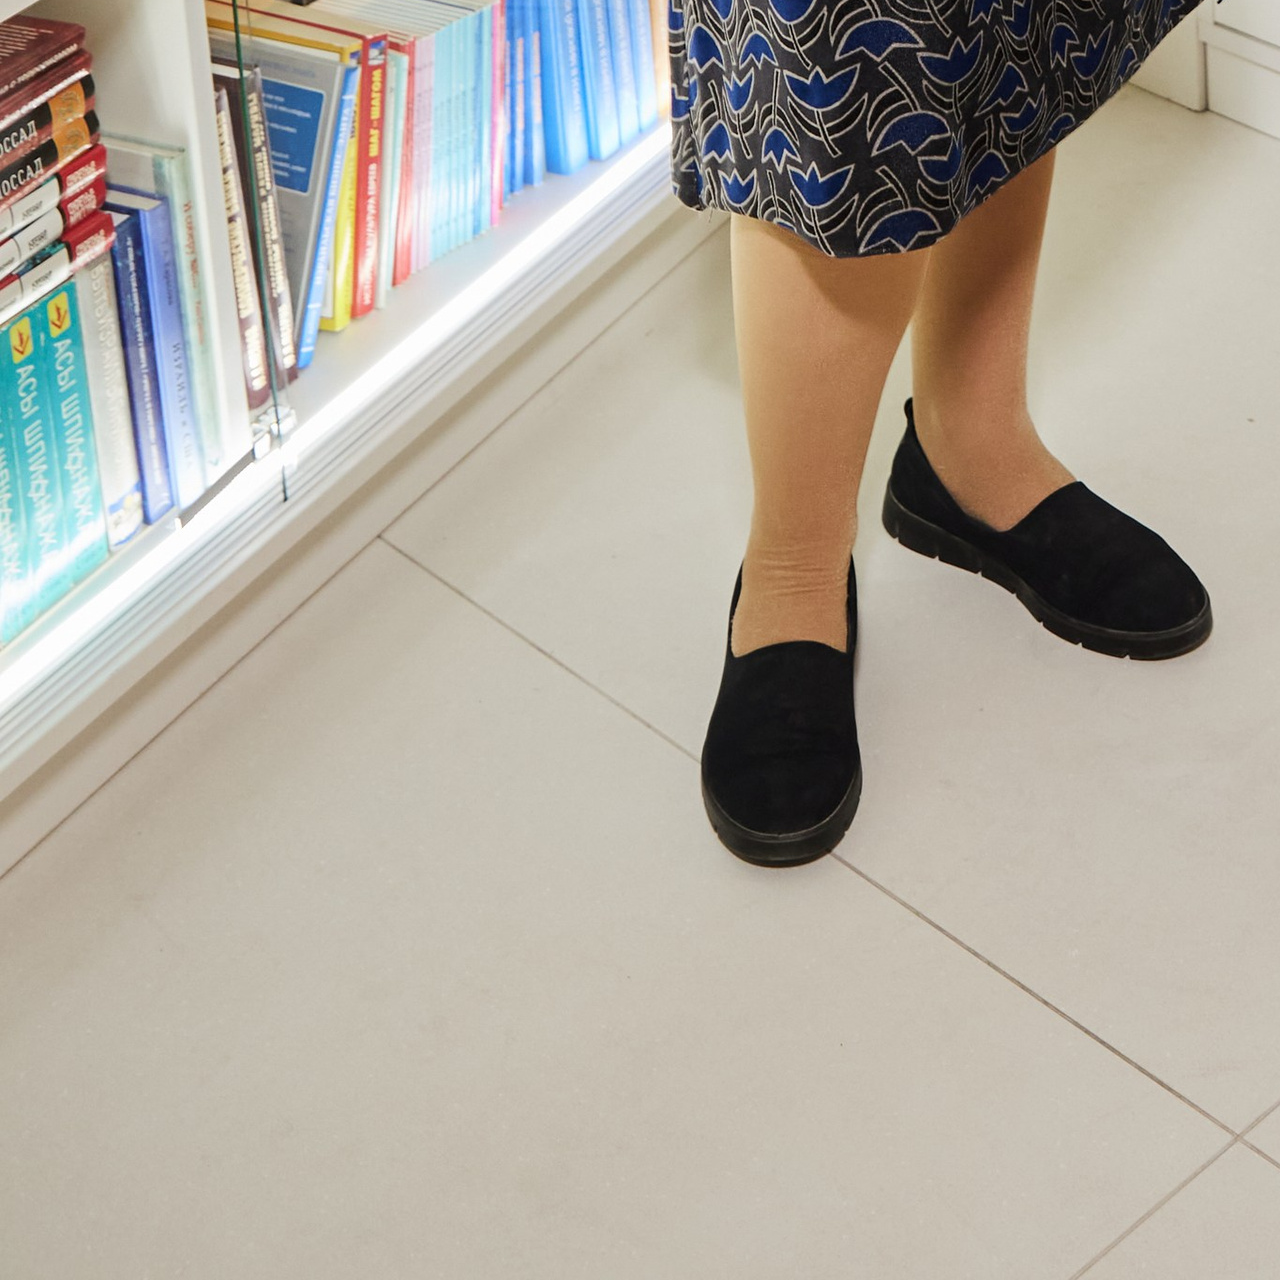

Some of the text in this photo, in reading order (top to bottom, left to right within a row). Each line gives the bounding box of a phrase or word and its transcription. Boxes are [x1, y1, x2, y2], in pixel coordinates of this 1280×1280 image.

[0, 120, 38, 159] ОССАД
[0, 157, 44, 198] ОССАД
[52, 339, 77, 391] АСЫ
[14, 365, 39, 418] АСЫ
